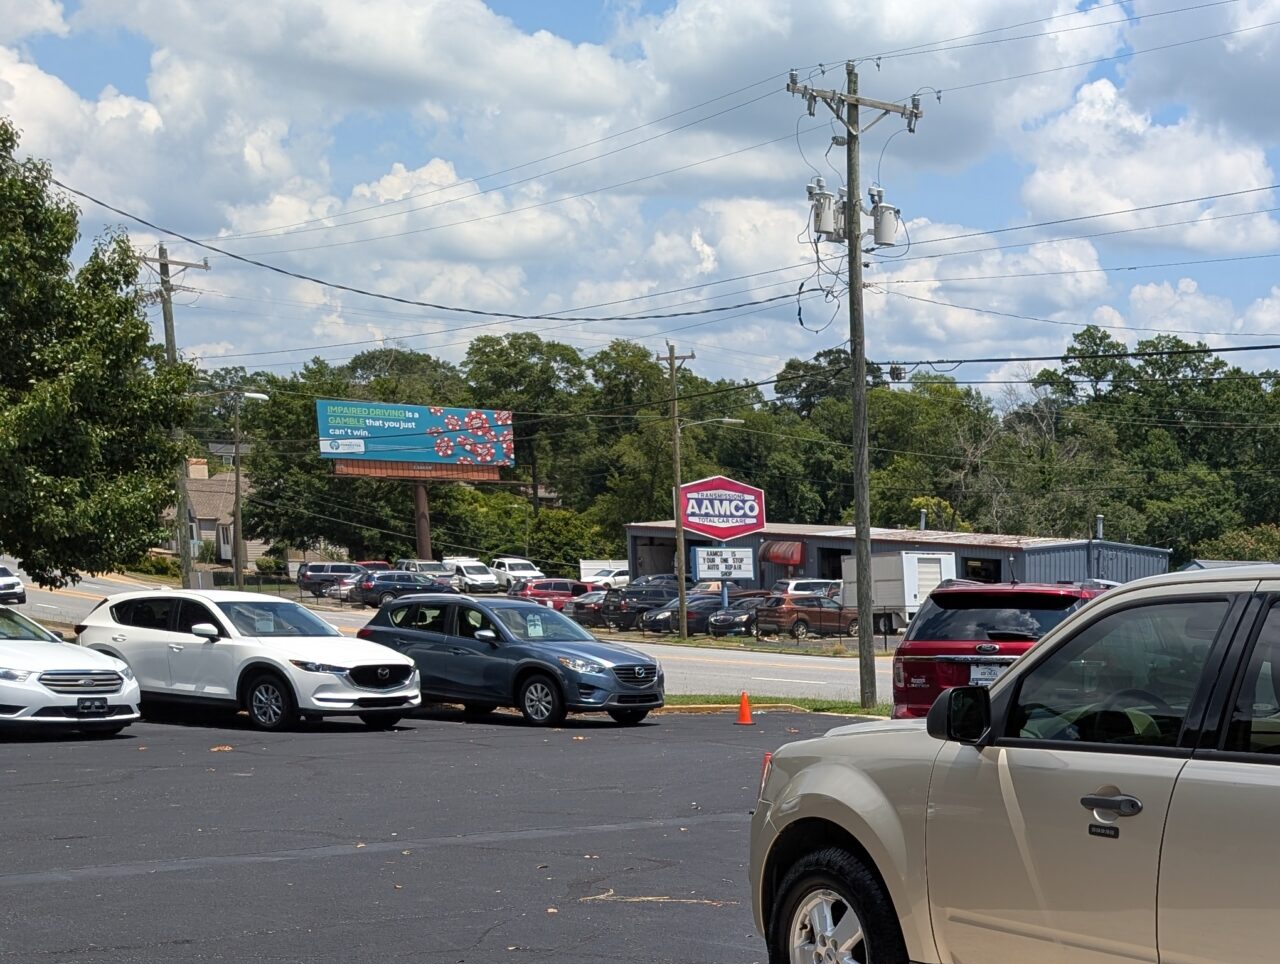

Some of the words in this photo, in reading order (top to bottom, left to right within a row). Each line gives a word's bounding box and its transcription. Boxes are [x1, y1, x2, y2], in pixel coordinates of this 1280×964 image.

[327, 406, 368, 415] IMPAIRED
[370, 408, 405, 417] DRIVING
[405, 410, 412, 418] is
[328, 417, 365, 425] GAMBLE
[365, 419, 383, 427] that
[384, 421, 400, 429] you
[400, 421, 416, 429] just
[329, 428, 352, 436] can't
[353, 429, 371, 437] win.
[697, 492, 745, 500] TRANSMISSIONS
[686, 499, 759, 516] AAMCO
